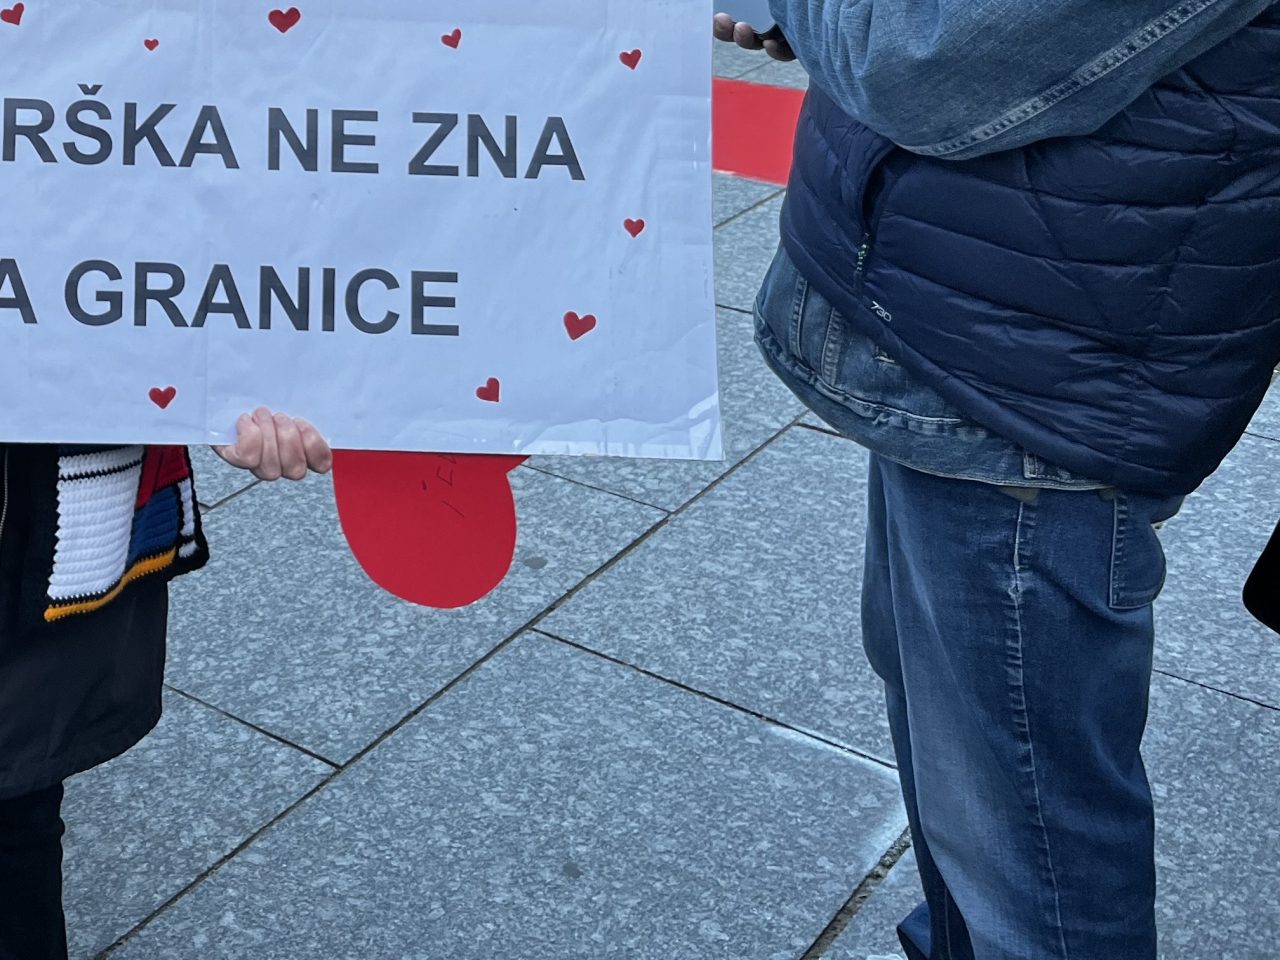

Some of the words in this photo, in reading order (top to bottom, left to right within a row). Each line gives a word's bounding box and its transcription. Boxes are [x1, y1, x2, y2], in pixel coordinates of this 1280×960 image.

[267, 107, 380, 175] NE
[407, 111, 586, 182] ZNA
[64, 259, 460, 337] GRANICE
[870, 300, 892, 322] 730
